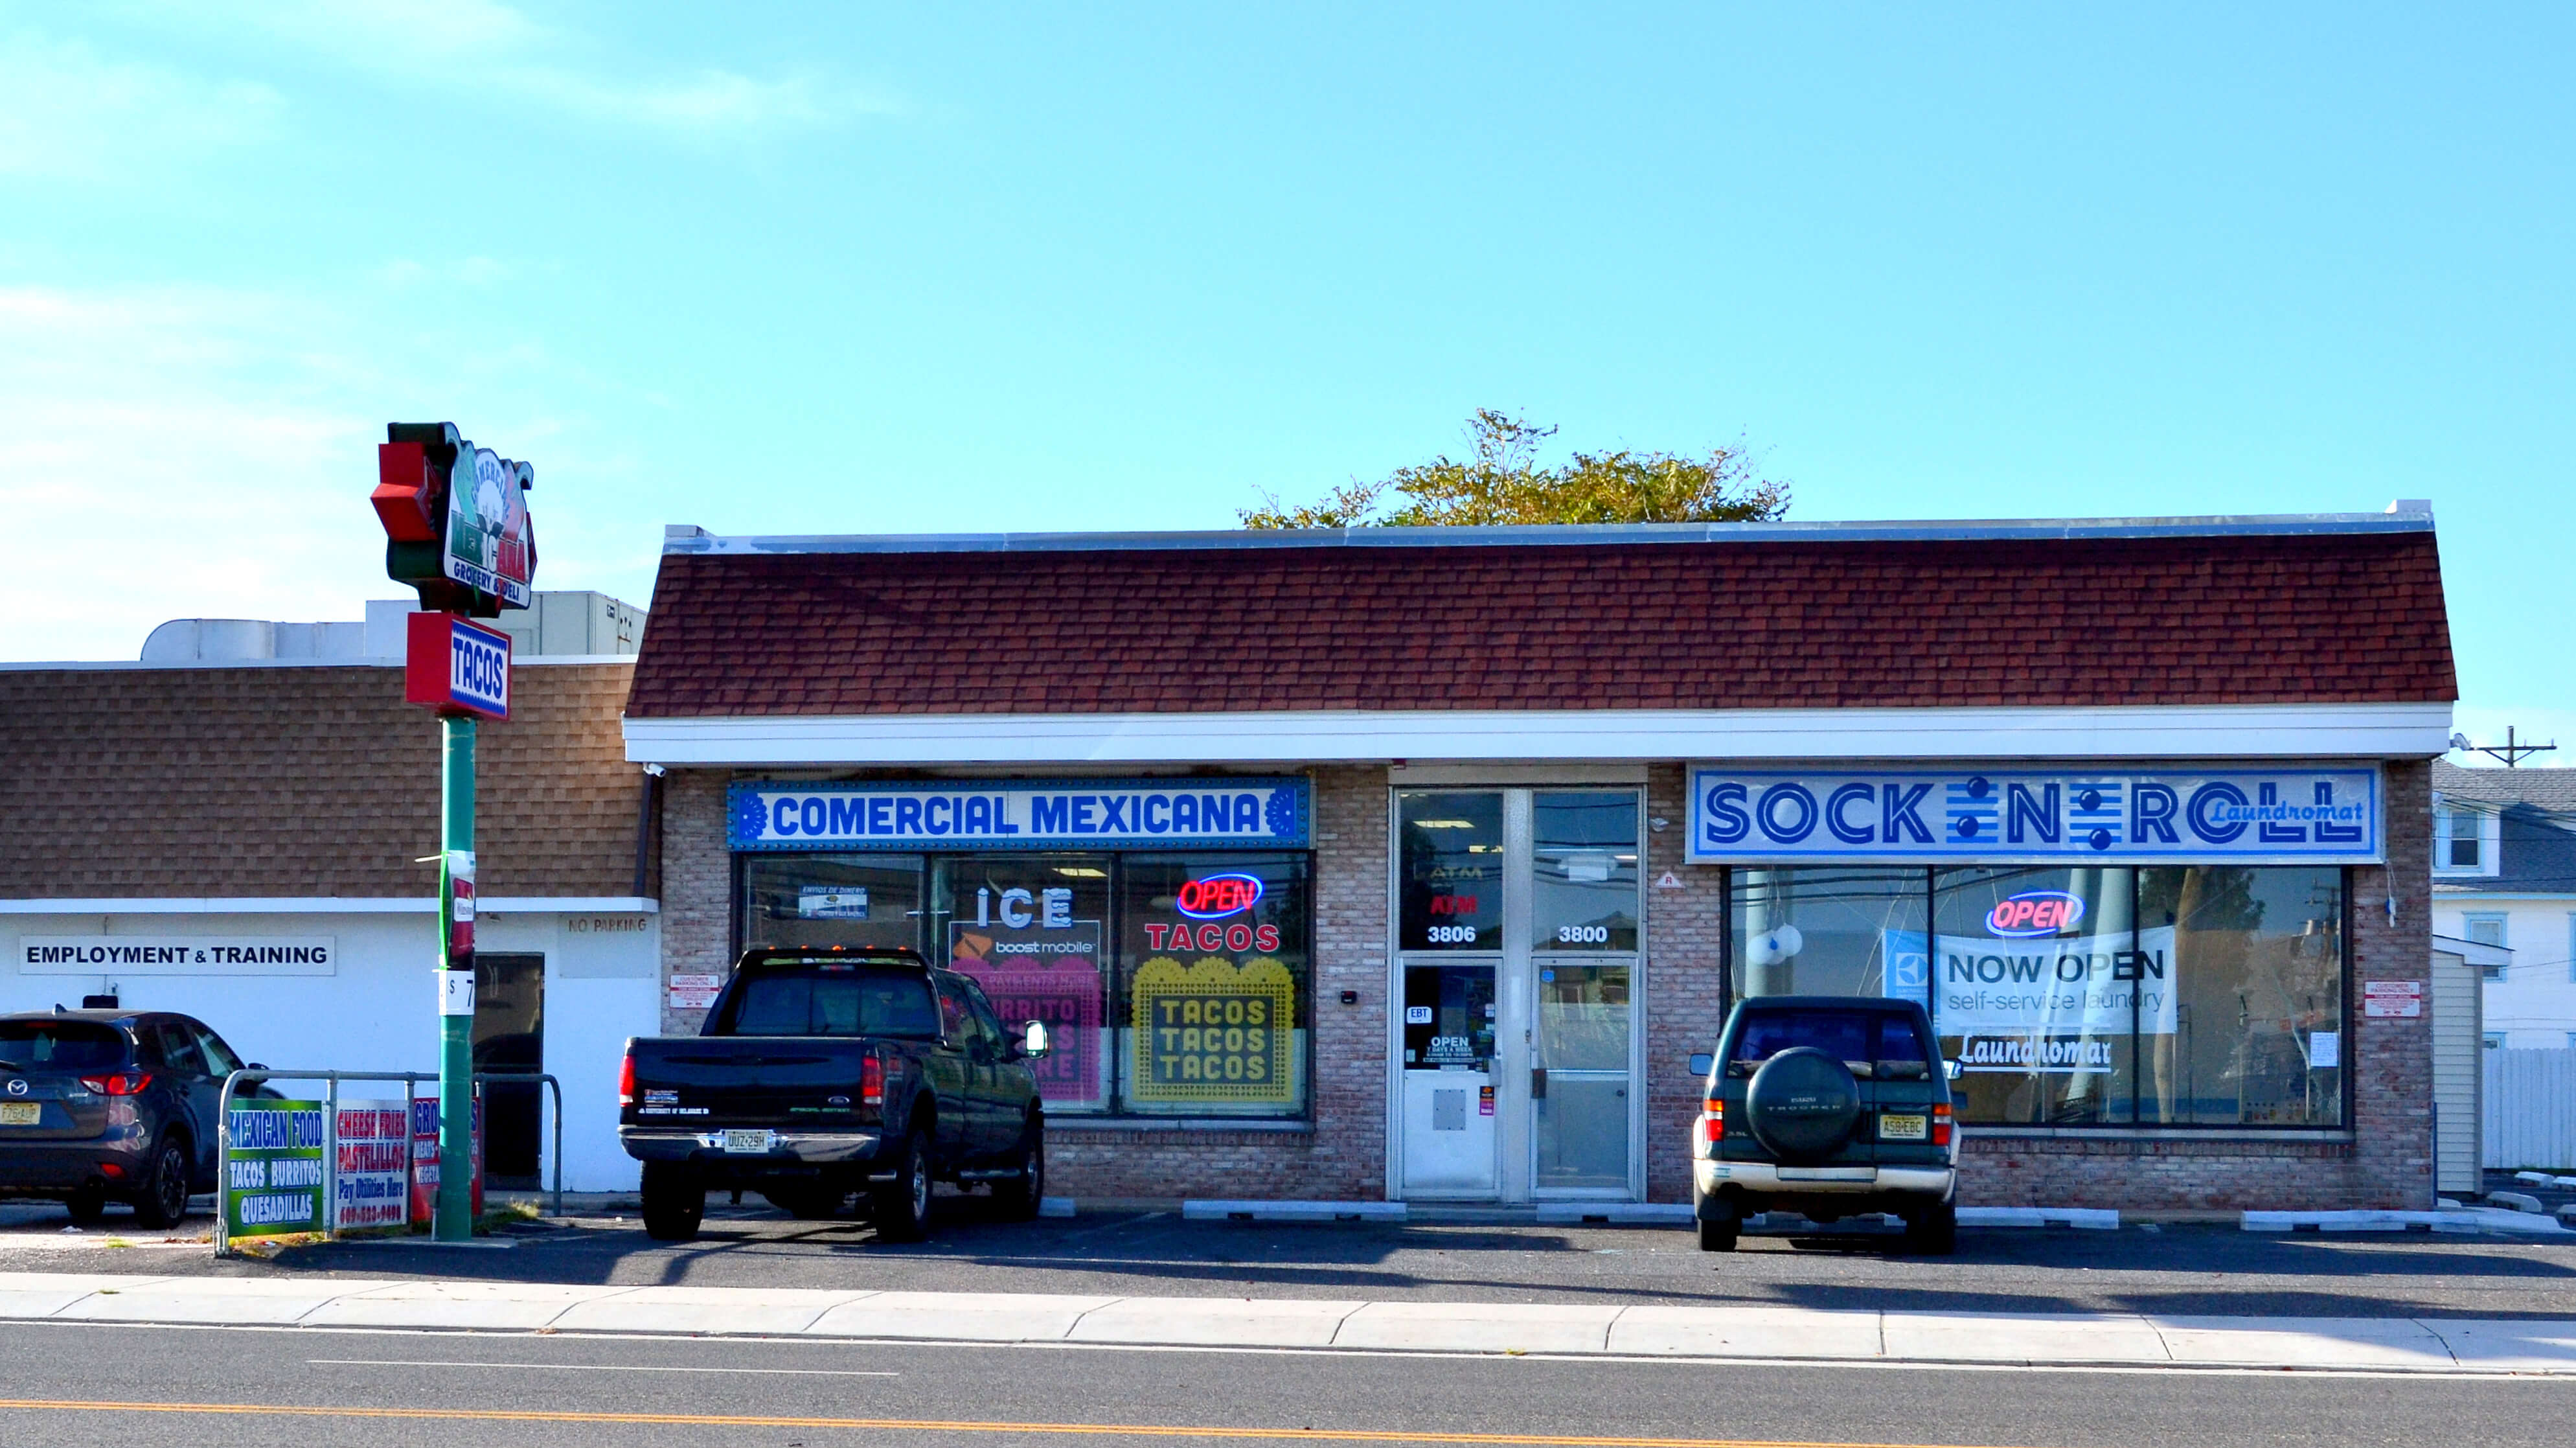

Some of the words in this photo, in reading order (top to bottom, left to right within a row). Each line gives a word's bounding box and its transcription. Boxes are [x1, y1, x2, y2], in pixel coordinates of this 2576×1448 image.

[453, 561, 492, 590] GROCERY
[502, 580, 520, 602] DELI
[453, 637, 503, 699] TACOS
[773, 796, 1019, 836] COMERCIAL
[1031, 794, 1260, 834] MEXICANA
[1706, 782, 1936, 845] SOCK
[2007, 783, 2060, 844] N
[2130, 781, 2363, 844] ROLL
[2209, 800, 2364, 822] Laundromat
[1665, 876, 1672, 884] R
[977, 886, 1074, 929] ICE
[1179, 880, 1256, 911] OPEN
[1430, 895, 1477, 915] ATM
[568, 919, 587, 932] NO
[594, 918, 647, 932] PARKING
[1992, 901, 2075, 928] OPEN
[996, 941, 1040, 953] boost
[1042, 941, 1093, 953] mobile
[1145, 923, 1281, 952] TACOS
[1428, 926, 1476, 943] 3806
[1558, 926, 1608, 943] 3800
[27, 947, 190, 963] EMPLOYMENT
[194, 950, 207, 963] &
[211, 946, 327, 964] TRAINING
[1948, 954, 2044, 983] NOW
[2056, 950, 2164, 983] OPEN
[466, 979, 474, 1007] 7
[989, 976, 1056, 985] PAYMENTS
[1159, 1000, 1266, 1024] TACOS
[1410, 1007, 1428, 1018] EBT
[1948, 991, 2075, 1010] self-service
[2082, 989, 2165, 1013] laundry
[1159, 1028, 1266, 1052] TACOS
[1431, 1036, 1469, 1047] OPEN
[1958, 1029, 2112, 1064] Laundromat
[1159, 1055, 1266, 1079] TACOS
[229, 1110, 288, 1150] MEXICAN
[291, 1110, 322, 1149] FOOD
[337, 1110, 376, 1140] CHEESE
[379, 1110, 406, 1140] FRIES
[337, 1143, 405, 1174] PASTELILLOS
[415, 1140, 435, 1160] MEATS
[229, 1160, 265, 1189] TACOS
[271, 1158, 322, 1188] BURRITOS
[339, 1178, 354, 1204] Pay
[356, 1177, 385, 1199] Utilities
[387, 1177, 404, 1197] Here
[240, 1193, 312, 1224] QUESADILLAS
